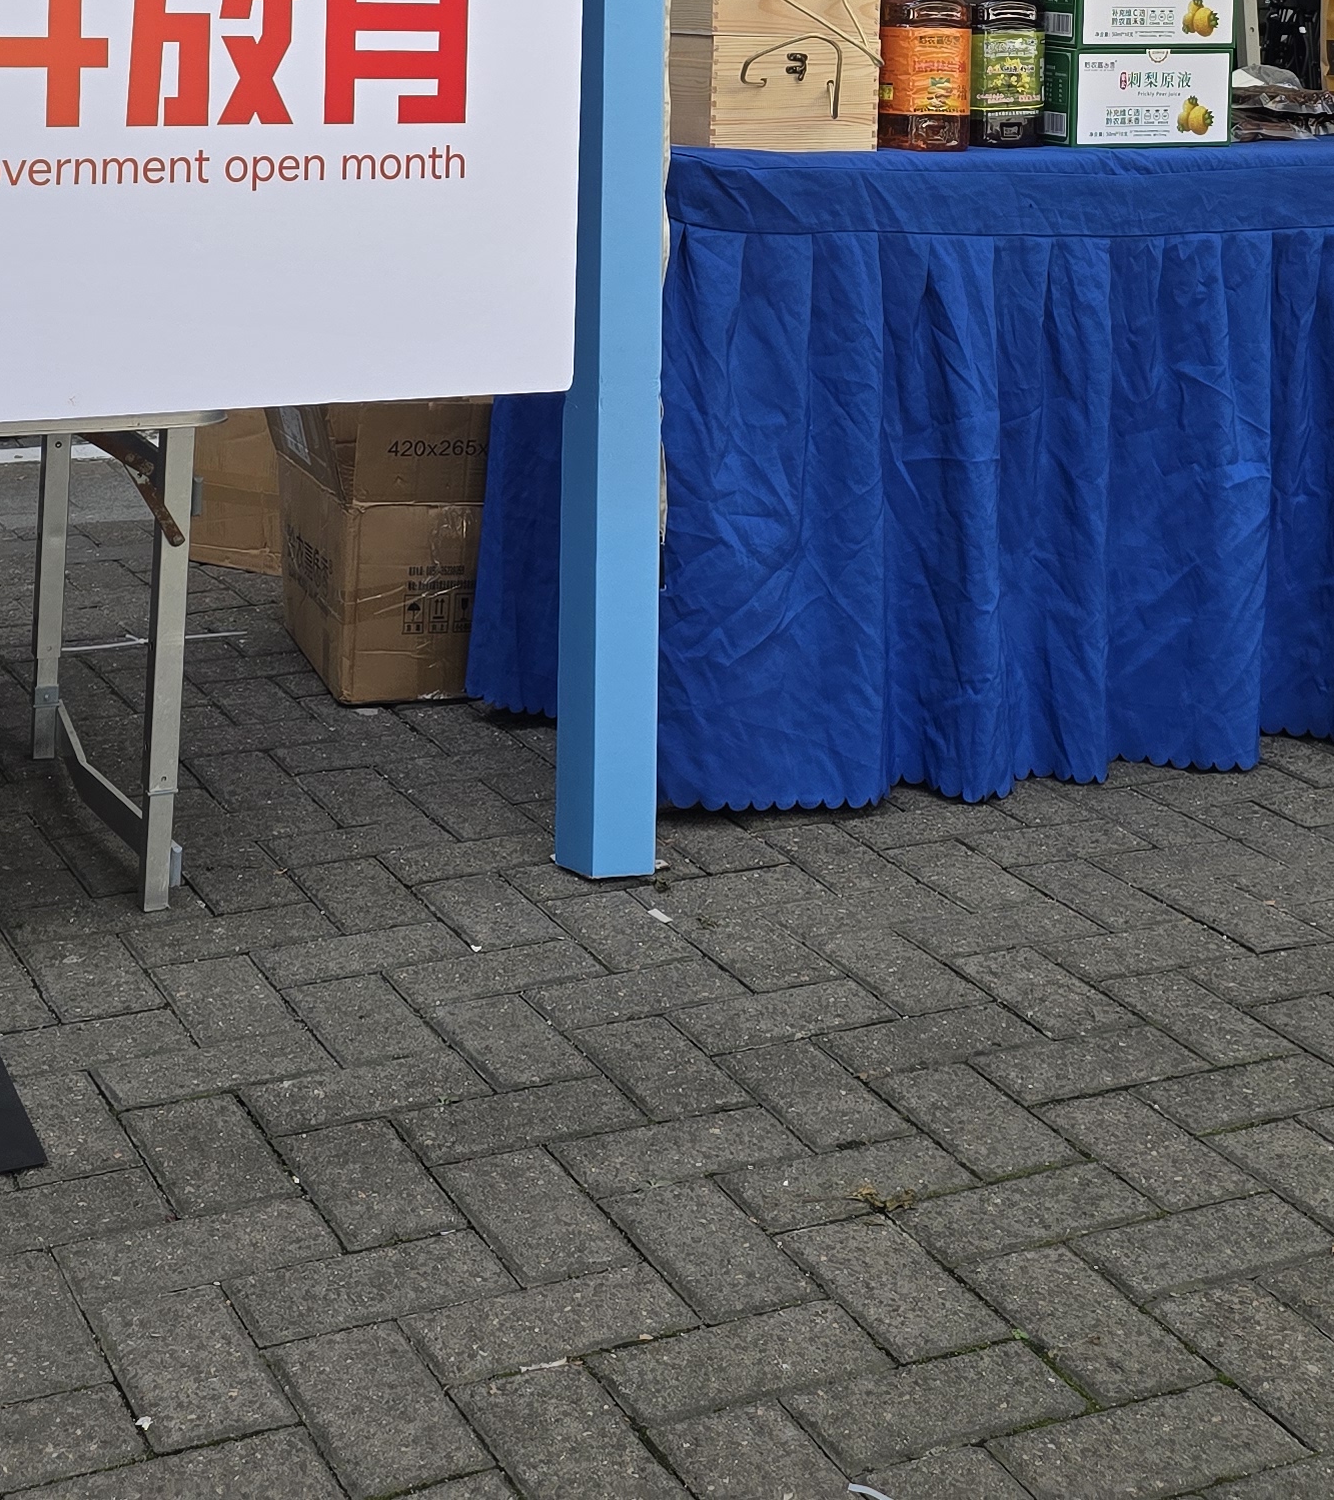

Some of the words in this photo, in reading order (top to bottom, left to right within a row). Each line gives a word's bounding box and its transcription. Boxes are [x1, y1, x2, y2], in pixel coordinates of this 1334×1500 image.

[1127, 71, 1192, 89] 刺梨原液
[224, 149, 325, 191] open
[340, 145, 466, 182] month
